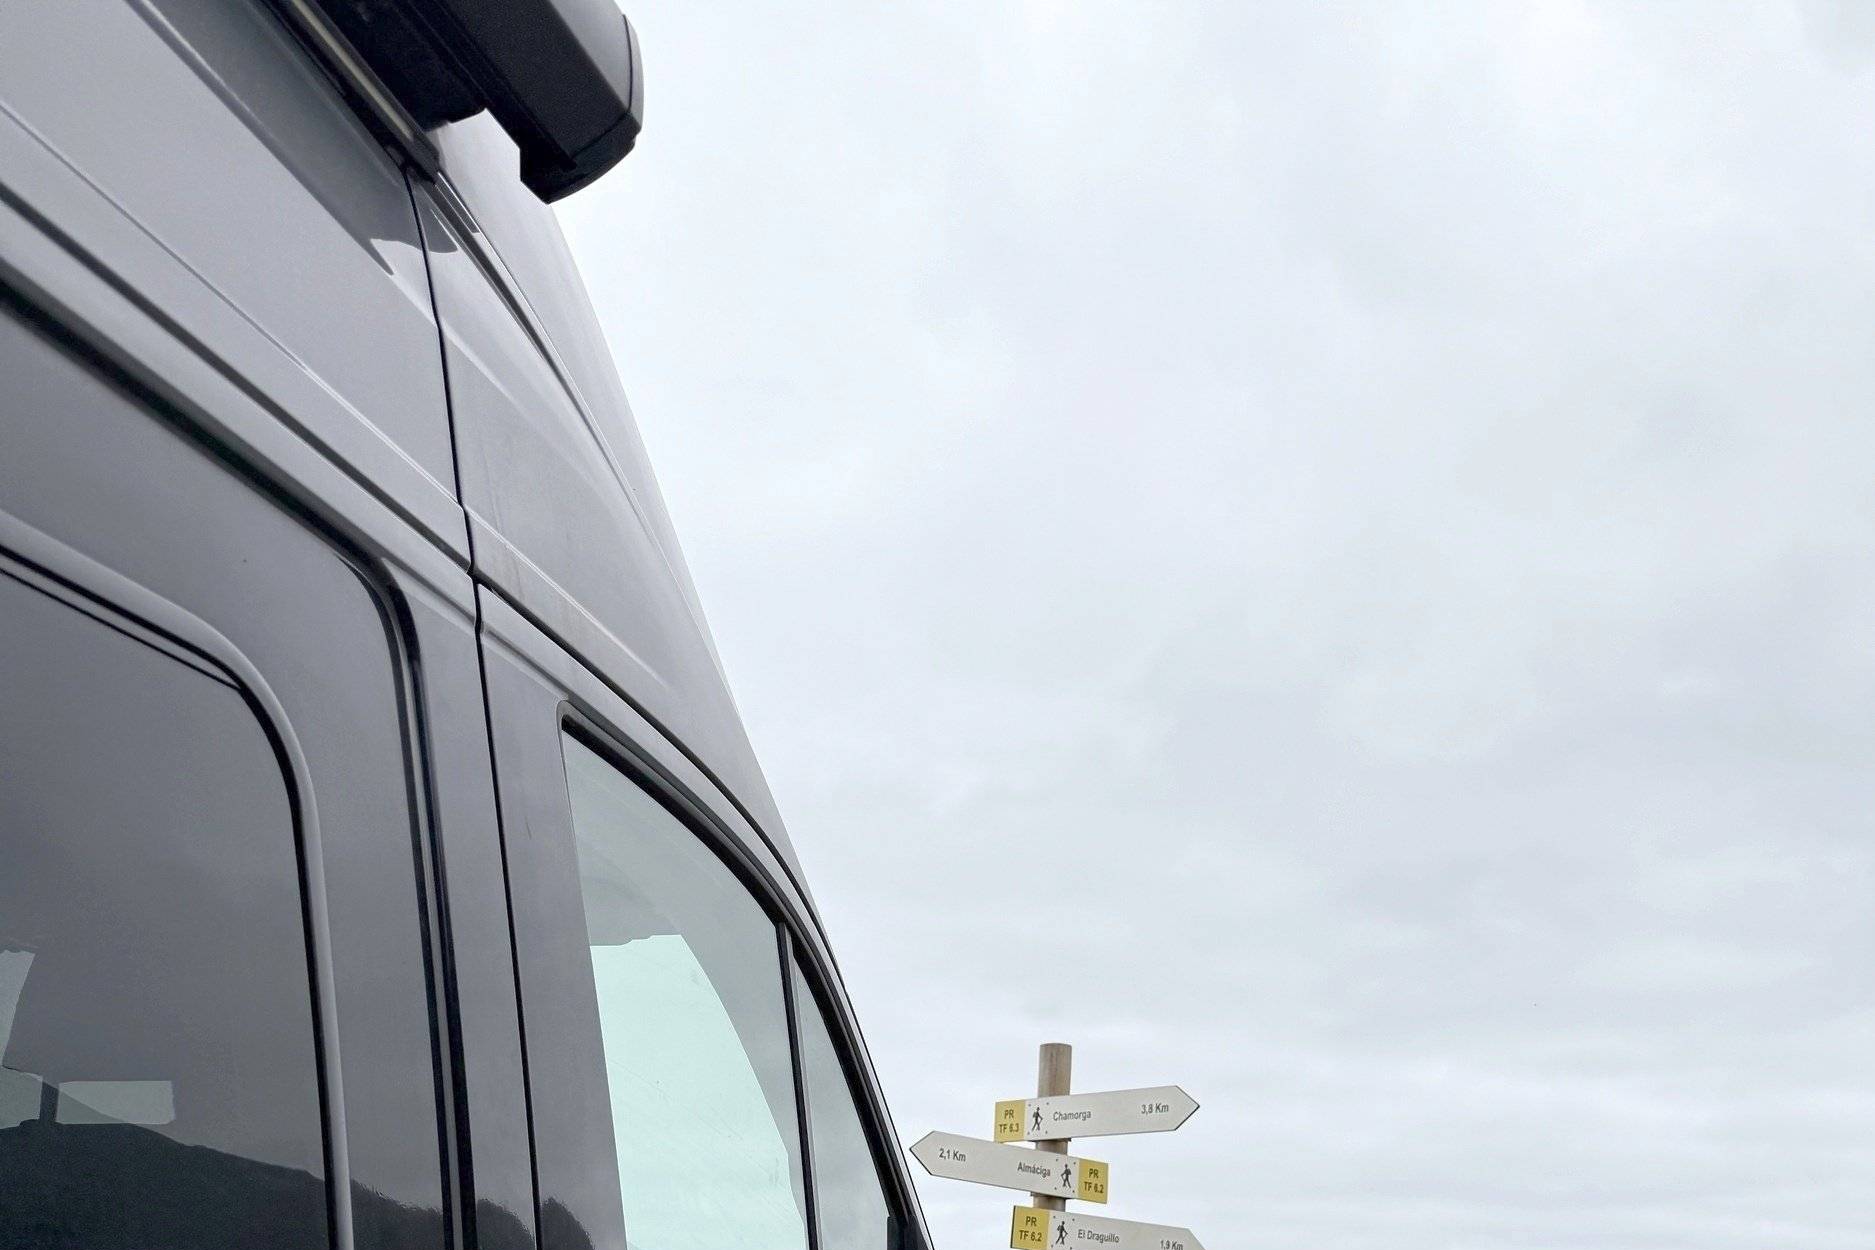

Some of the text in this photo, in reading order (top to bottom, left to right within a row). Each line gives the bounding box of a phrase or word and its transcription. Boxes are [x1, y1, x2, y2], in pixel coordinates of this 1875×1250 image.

[1004, 1109, 1014, 1119] PR
[1141, 1104, 1169, 1114] 3,8 Km
[1053, 1110, 1091, 1122] Chamorga
[998, 1123, 1007, 1133] TF
[939, 1148, 966, 1162] 2,1 Km
[1017, 1162, 1051, 1178] Almáciga
[1089, 1168, 1099, 1178] PR
[1084, 1181, 1104, 1193] TF 6.2
[1025, 1216, 1037, 1227] PR
[1019, 1230, 1042, 1242] TF 6.2
[1078, 1229, 1120, 1244] El Draguillo
[1160, 1240, 1183, 1250] 1,9 Km
